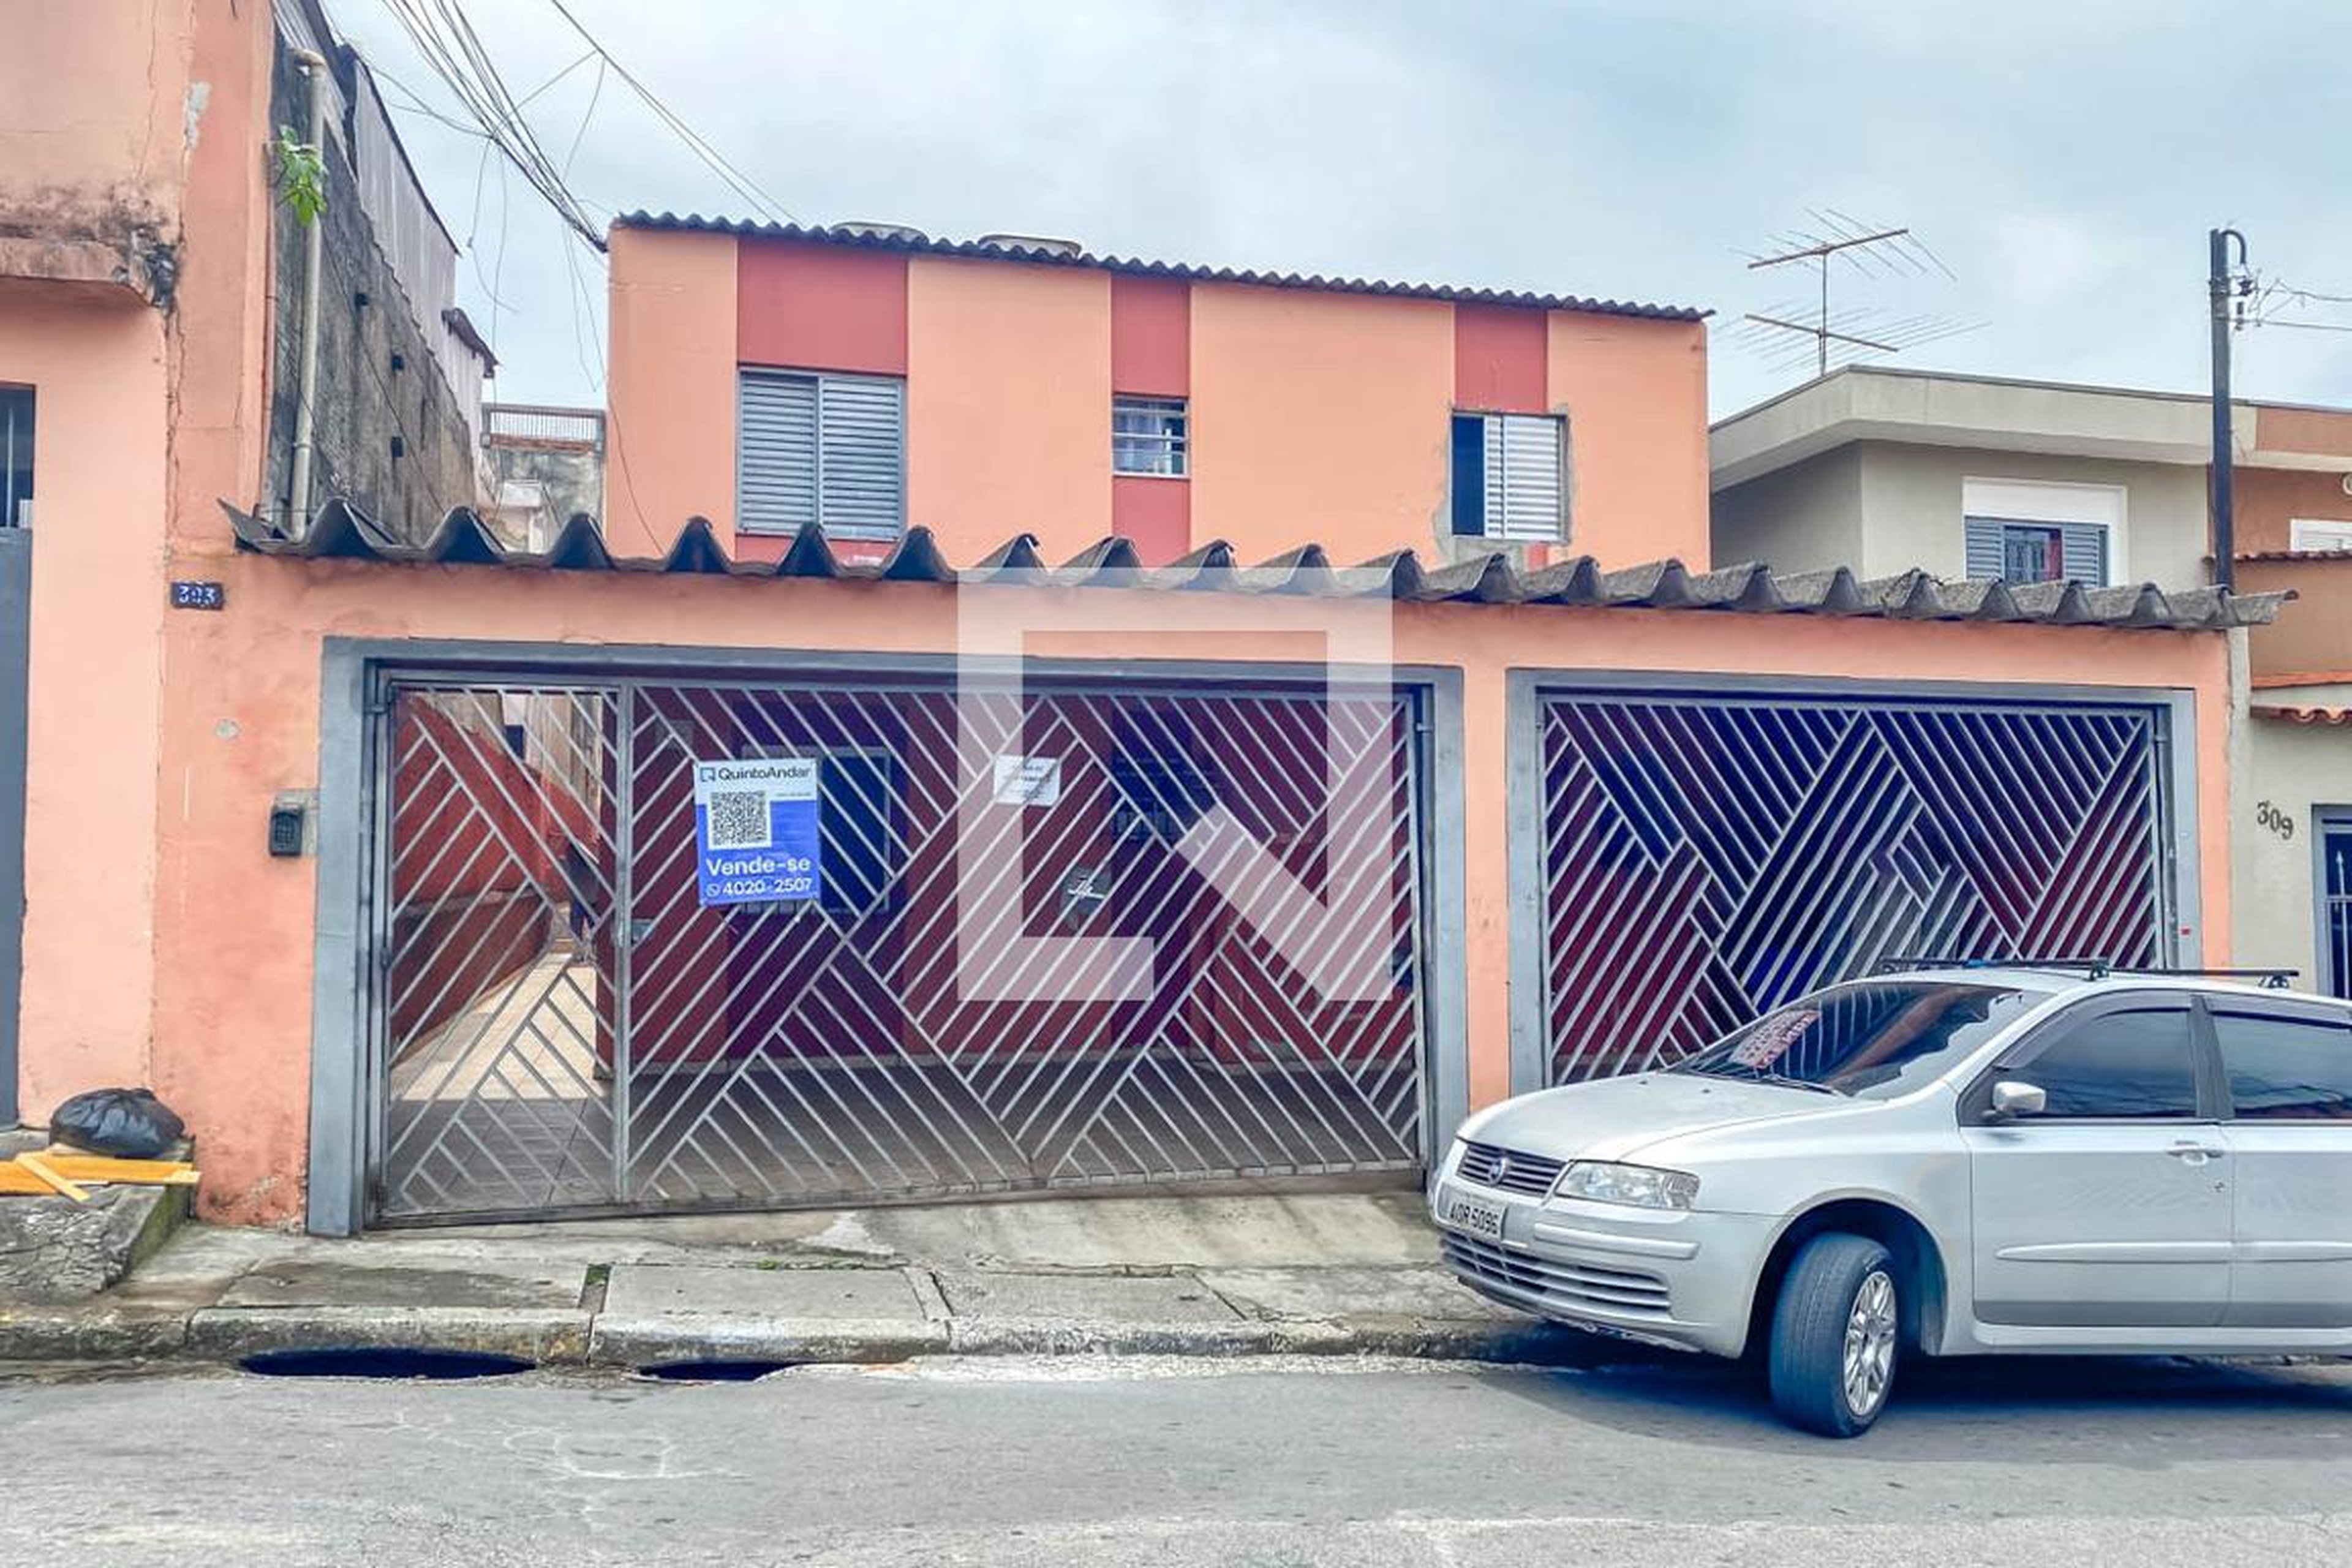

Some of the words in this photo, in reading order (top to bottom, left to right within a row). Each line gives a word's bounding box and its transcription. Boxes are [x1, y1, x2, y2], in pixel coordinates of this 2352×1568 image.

[718, 766, 810, 781] QuintoAndar
[2257, 800, 2293, 840] 309
[706, 856, 811, 876] Vende-se
